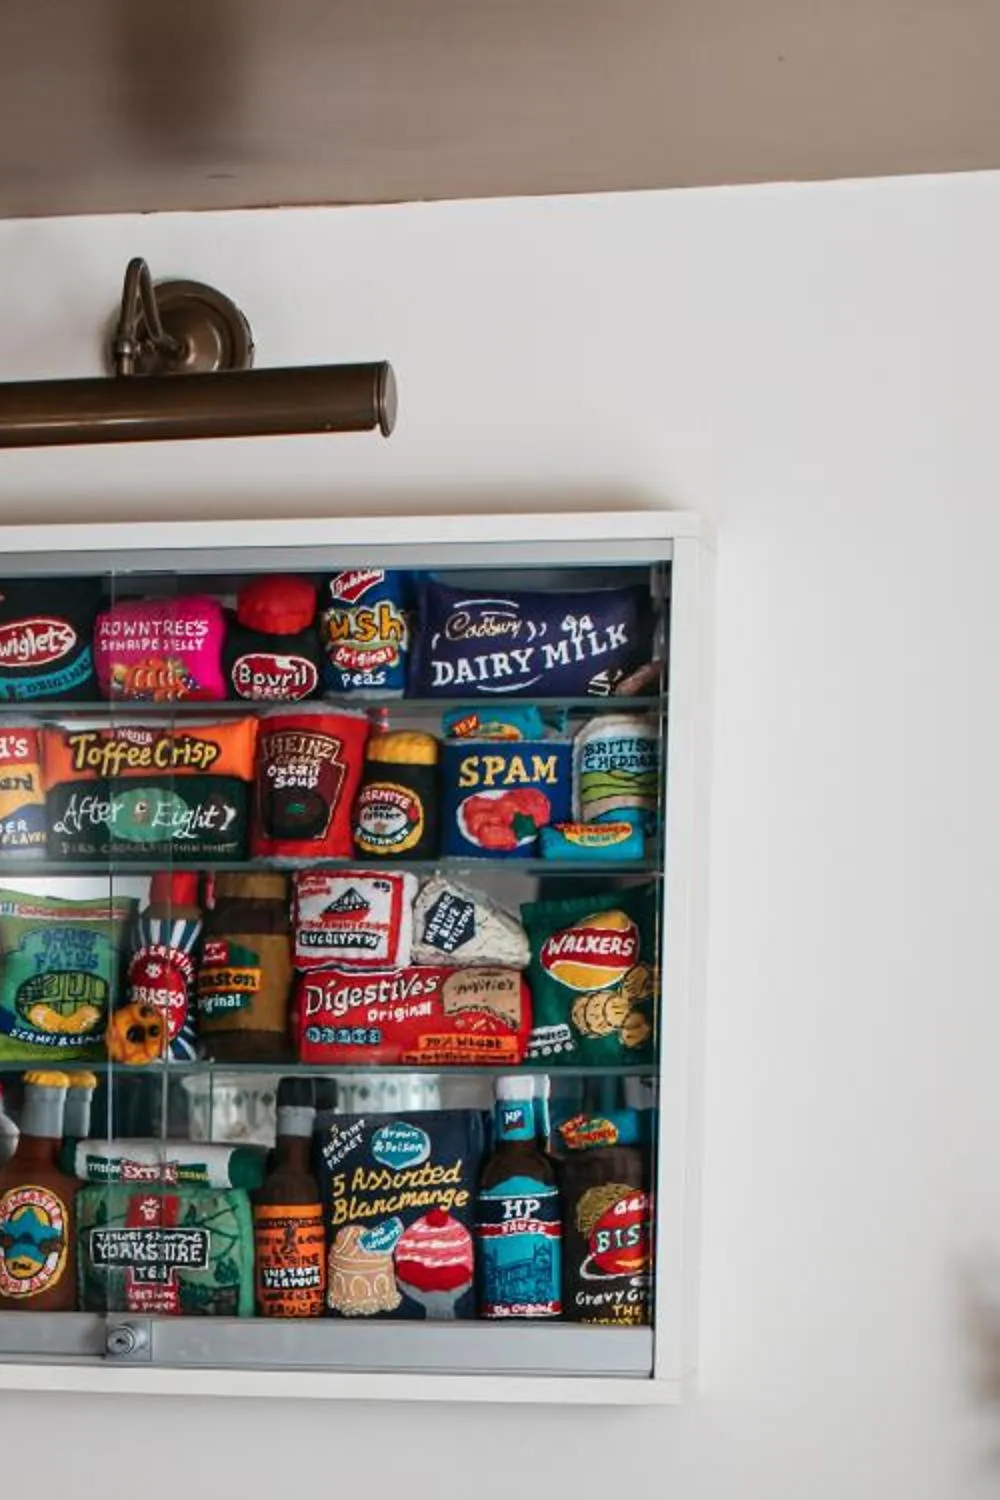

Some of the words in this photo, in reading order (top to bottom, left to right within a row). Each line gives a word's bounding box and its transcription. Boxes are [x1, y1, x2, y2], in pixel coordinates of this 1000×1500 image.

[445, 611, 523, 642] Cadbury
[430, 647, 536, 688] DAIRY
[541, 621, 629, 671] MILK
[239, 663, 308, 688] Bovril
[69, 733, 151, 777] Toffee
[154, 737, 218, 769] Crisp
[458, 755, 559, 788] SPAM
[54, 793, 125, 834] After
[151, 802, 220, 839] Eight
[547, 933, 636, 957] WALKERS
[305, 973, 440, 1017] Digestives
[504, 1108, 523, 1125] HP
[331, 1173, 347, 1197] 5
[351, 1158, 463, 1193] Assorted
[330, 1186, 470, 1226] Blancmange
[501, 1199, 541, 1219] HP
[596, 1224, 643, 1253] BIS
[575, 1288, 622, 1307] Gravy
